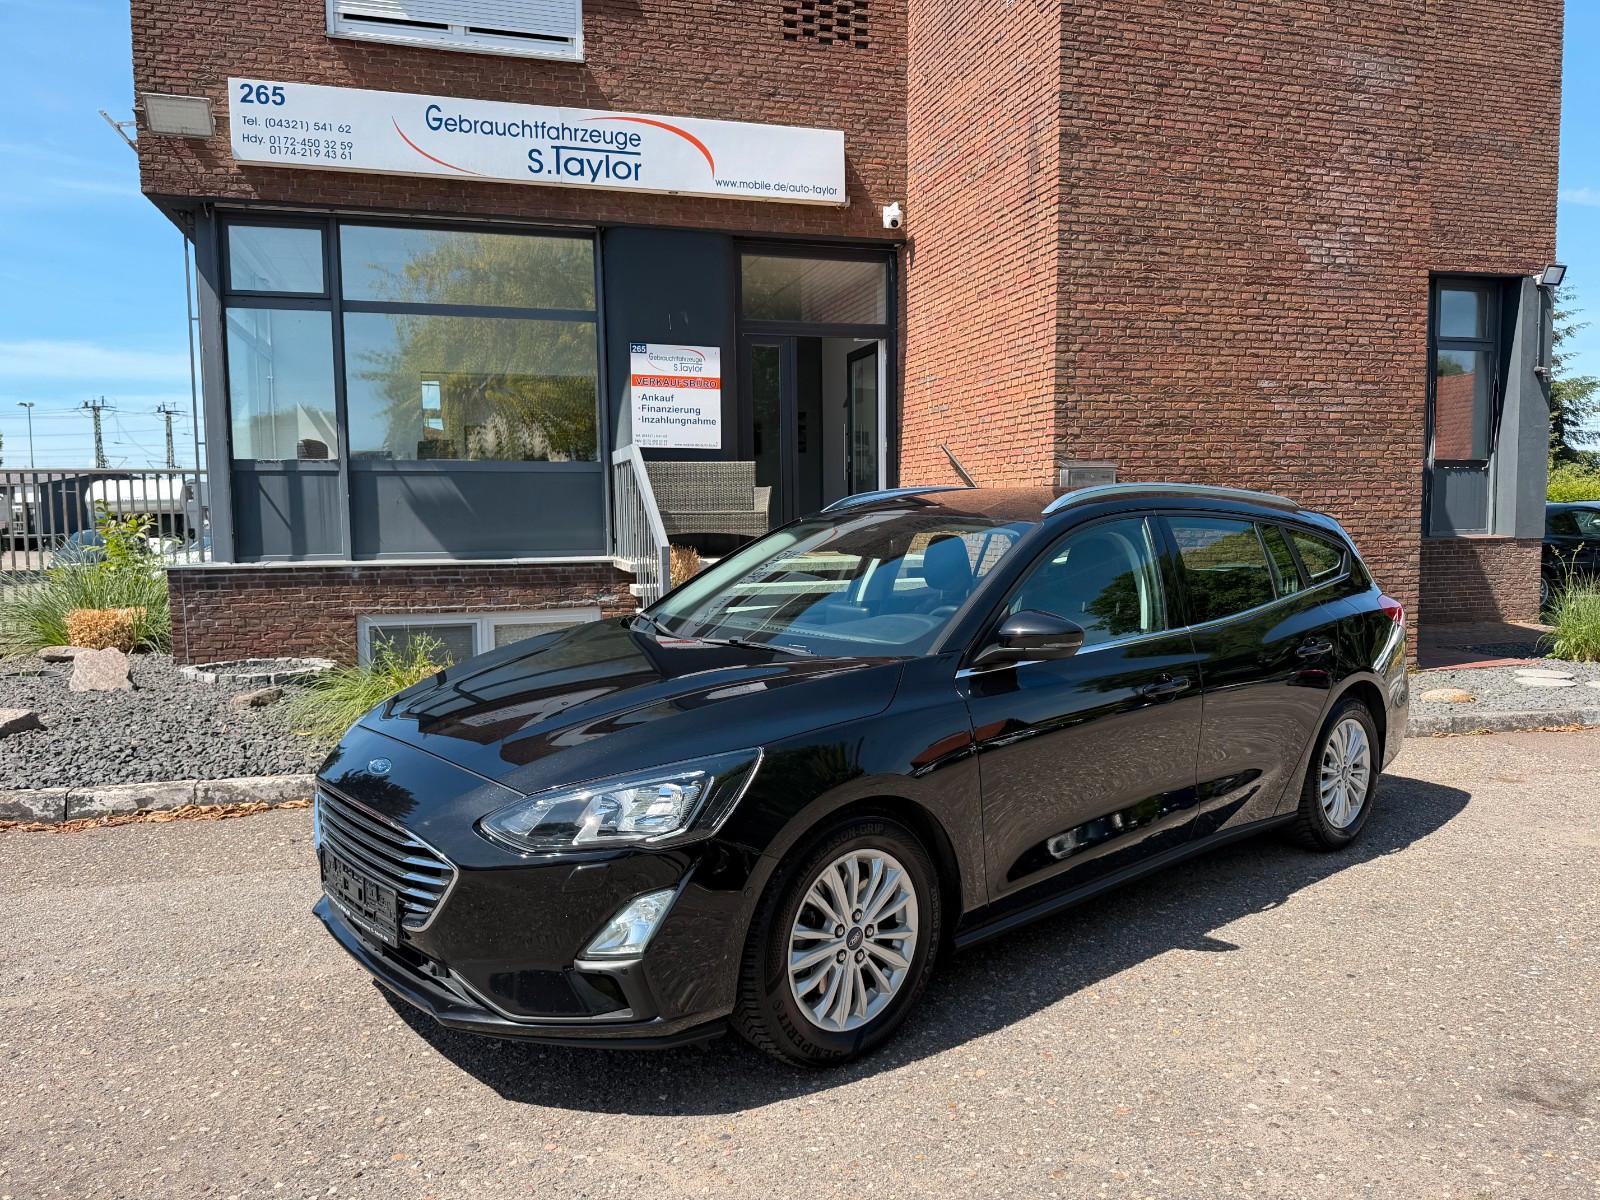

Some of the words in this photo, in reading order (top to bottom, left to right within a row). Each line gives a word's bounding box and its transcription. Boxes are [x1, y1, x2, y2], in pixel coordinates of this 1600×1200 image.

[239, 83, 286, 105] 265
[242, 115, 261, 127] Tel.
[265, 117, 309, 132] (04321)
[313, 122, 333, 132] 541
[337, 124, 352, 134] 62
[425, 104, 642, 150] Gebrauchtfahrzeuge
[242, 133, 265, 146] Hdy.
[269, 135, 321, 148] 0172-450
[324, 140, 338, 150] 32
[340, 141, 353, 151] 59
[269, 145, 321, 158] 0174-219
[324, 149, 337, 159] 43
[340, 150, 353, 161] 61
[527, 145, 642, 183] S.Taylor
[715, 179, 838, 197] www.mobile.de/auto-taylor
[632, 345, 646, 353] 265
[636, 377, 717, 388] VERKAUFSBÜRO
[641, 393, 675, 402] Ankauf
[641, 404, 701, 416] Finanzierung
[641, 415, 717, 426] Inzahlungnahme
